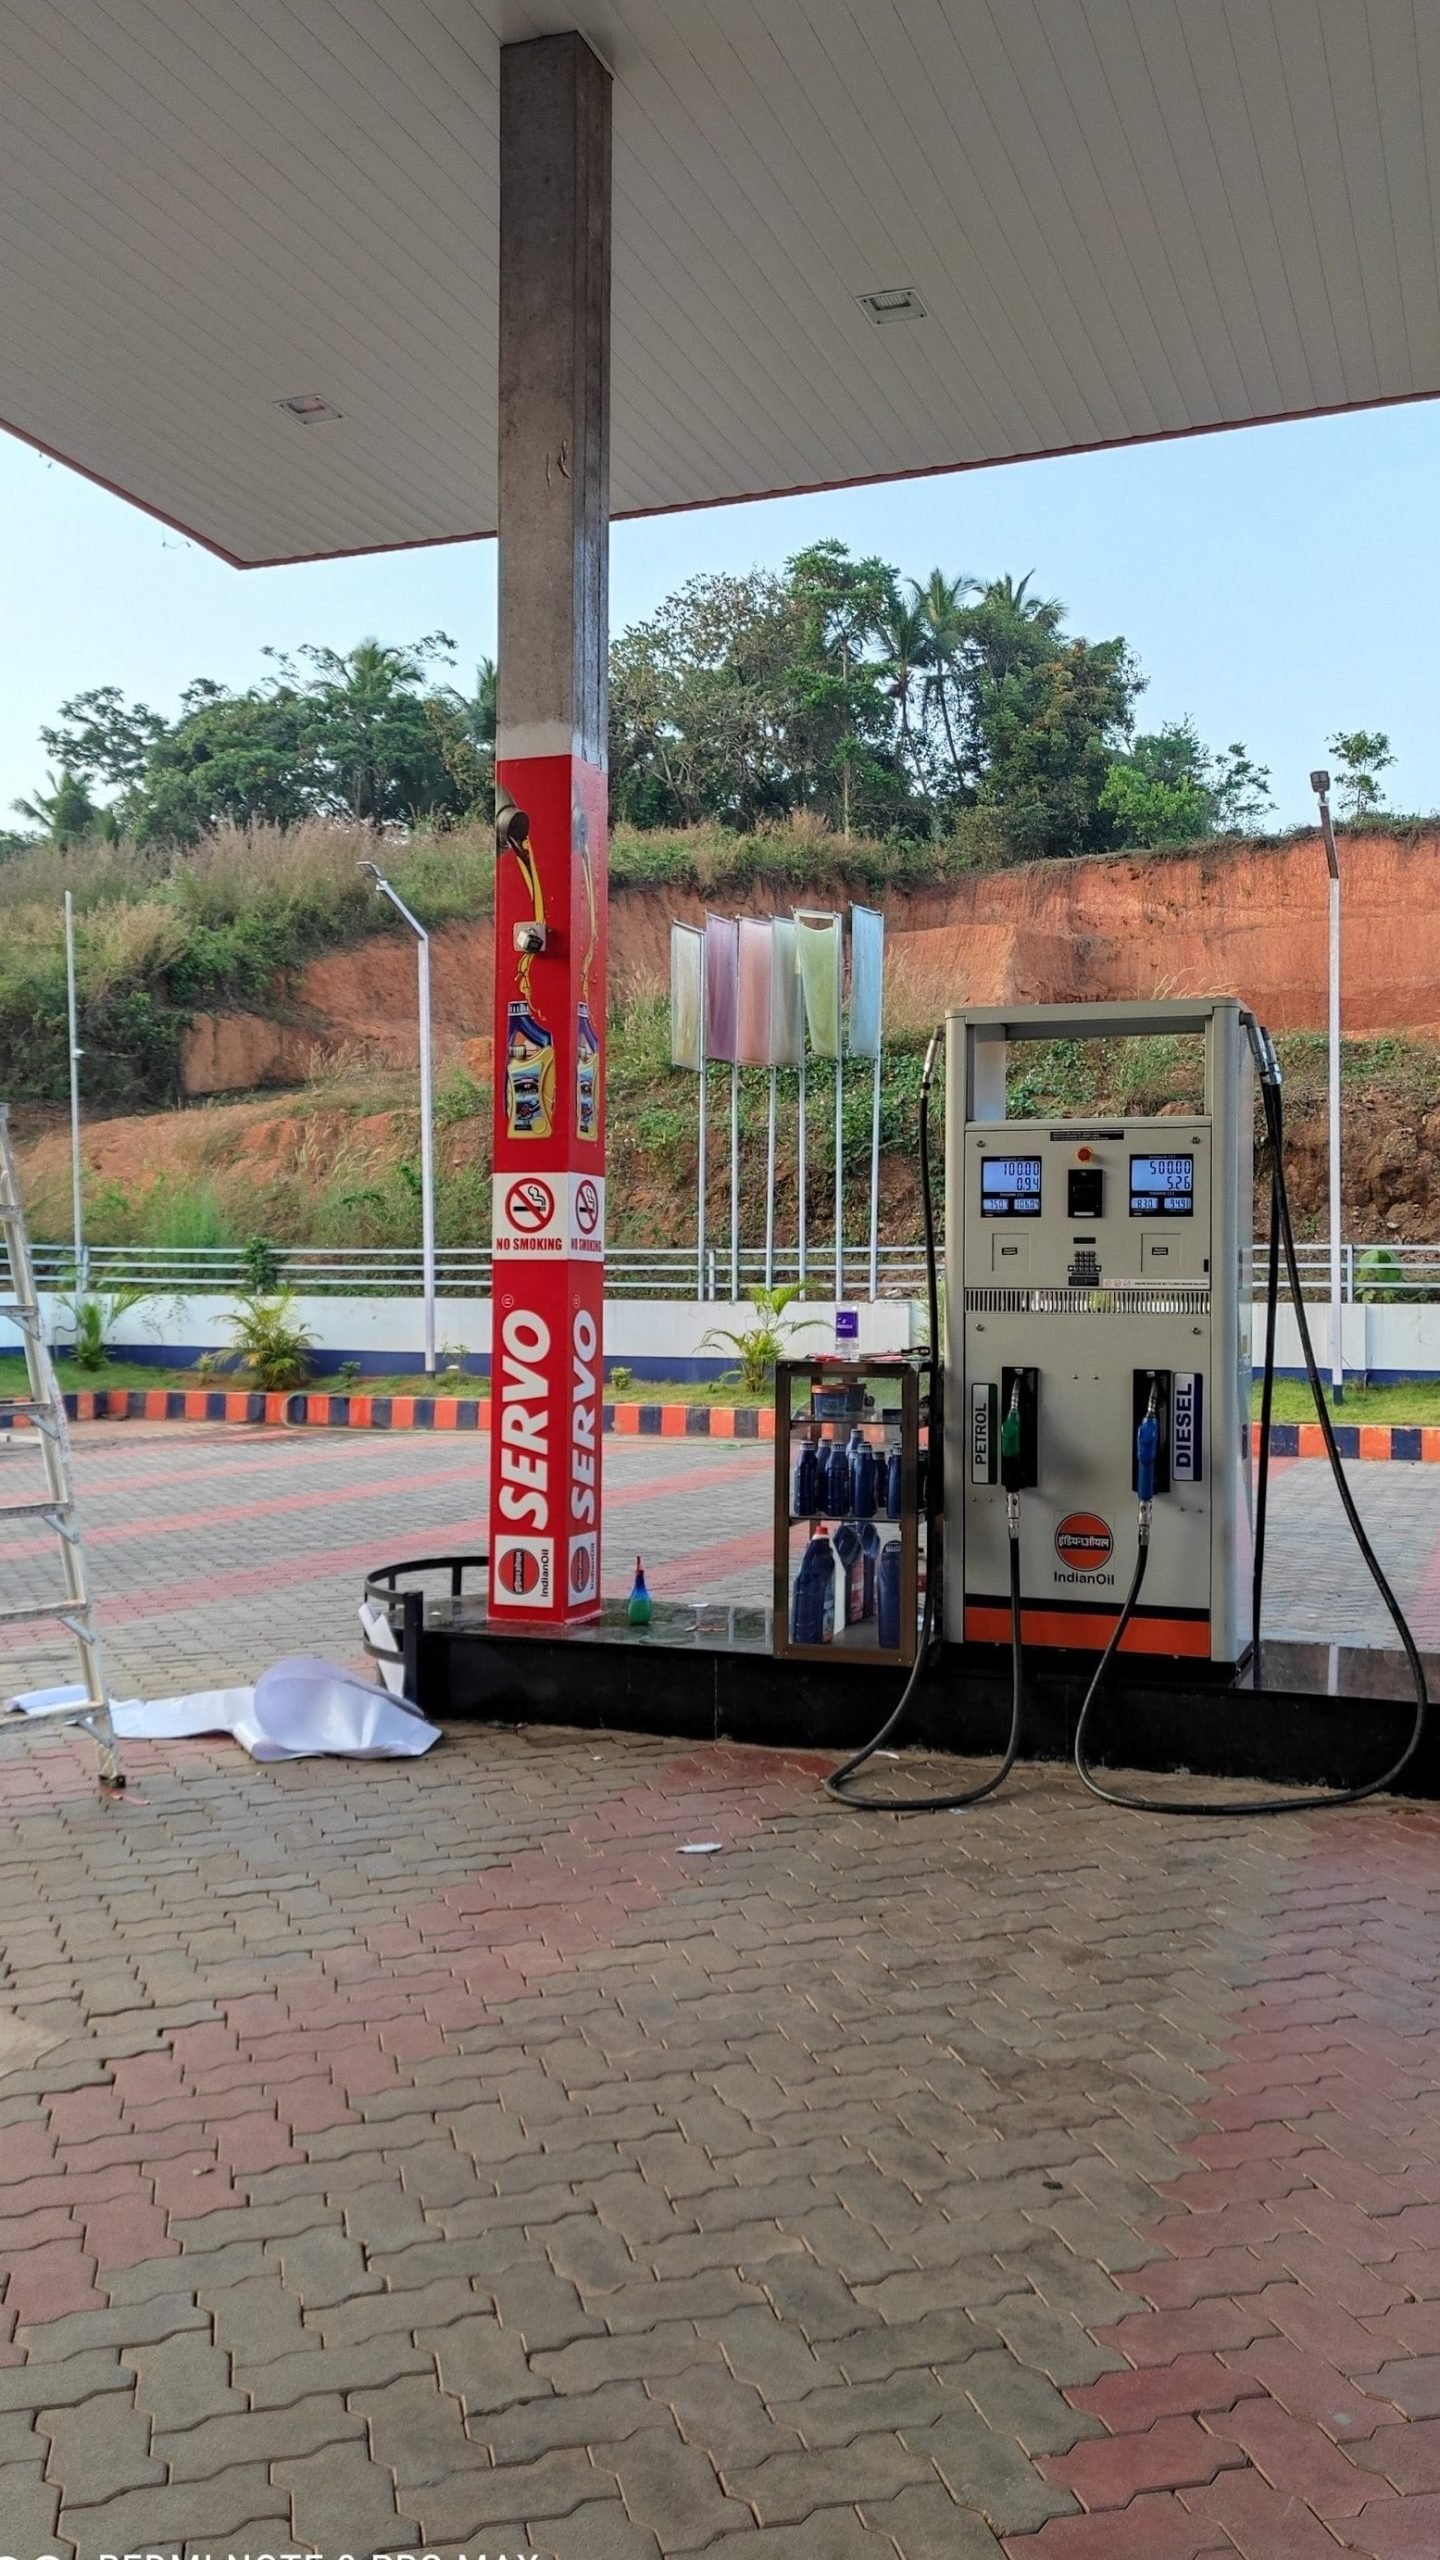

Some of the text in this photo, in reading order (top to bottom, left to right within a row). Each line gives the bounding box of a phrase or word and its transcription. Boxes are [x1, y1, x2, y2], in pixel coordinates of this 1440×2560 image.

[496, 1238, 562, 1251] NO SMOKING
[499, 1309, 550, 1530] SERVO
[570, 1309, 597, 1525] SERVO
[975, 1402, 987, 1465] PETROL
[1176, 1383, 1192, 1468] DIESEL
[541, 1549, 551, 1598] IndianOil
[1054, 1571, 1115, 1586] IndianOil
